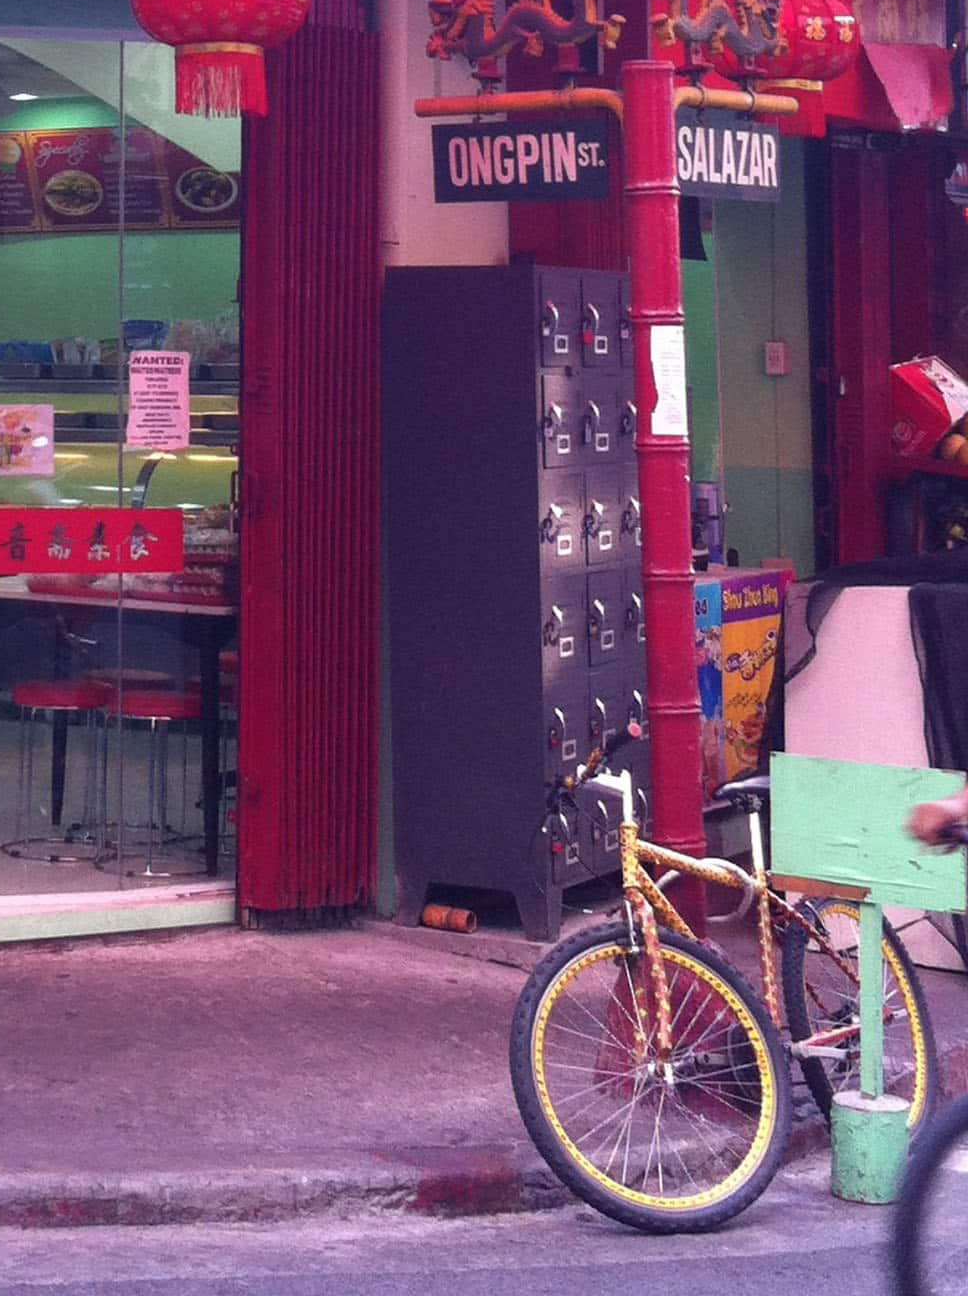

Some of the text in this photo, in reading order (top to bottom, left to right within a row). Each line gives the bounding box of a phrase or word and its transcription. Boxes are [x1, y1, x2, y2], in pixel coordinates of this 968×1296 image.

[448, 132, 605, 186] ONGPIN ST.
[677, 126, 778, 187] SALAZAR
